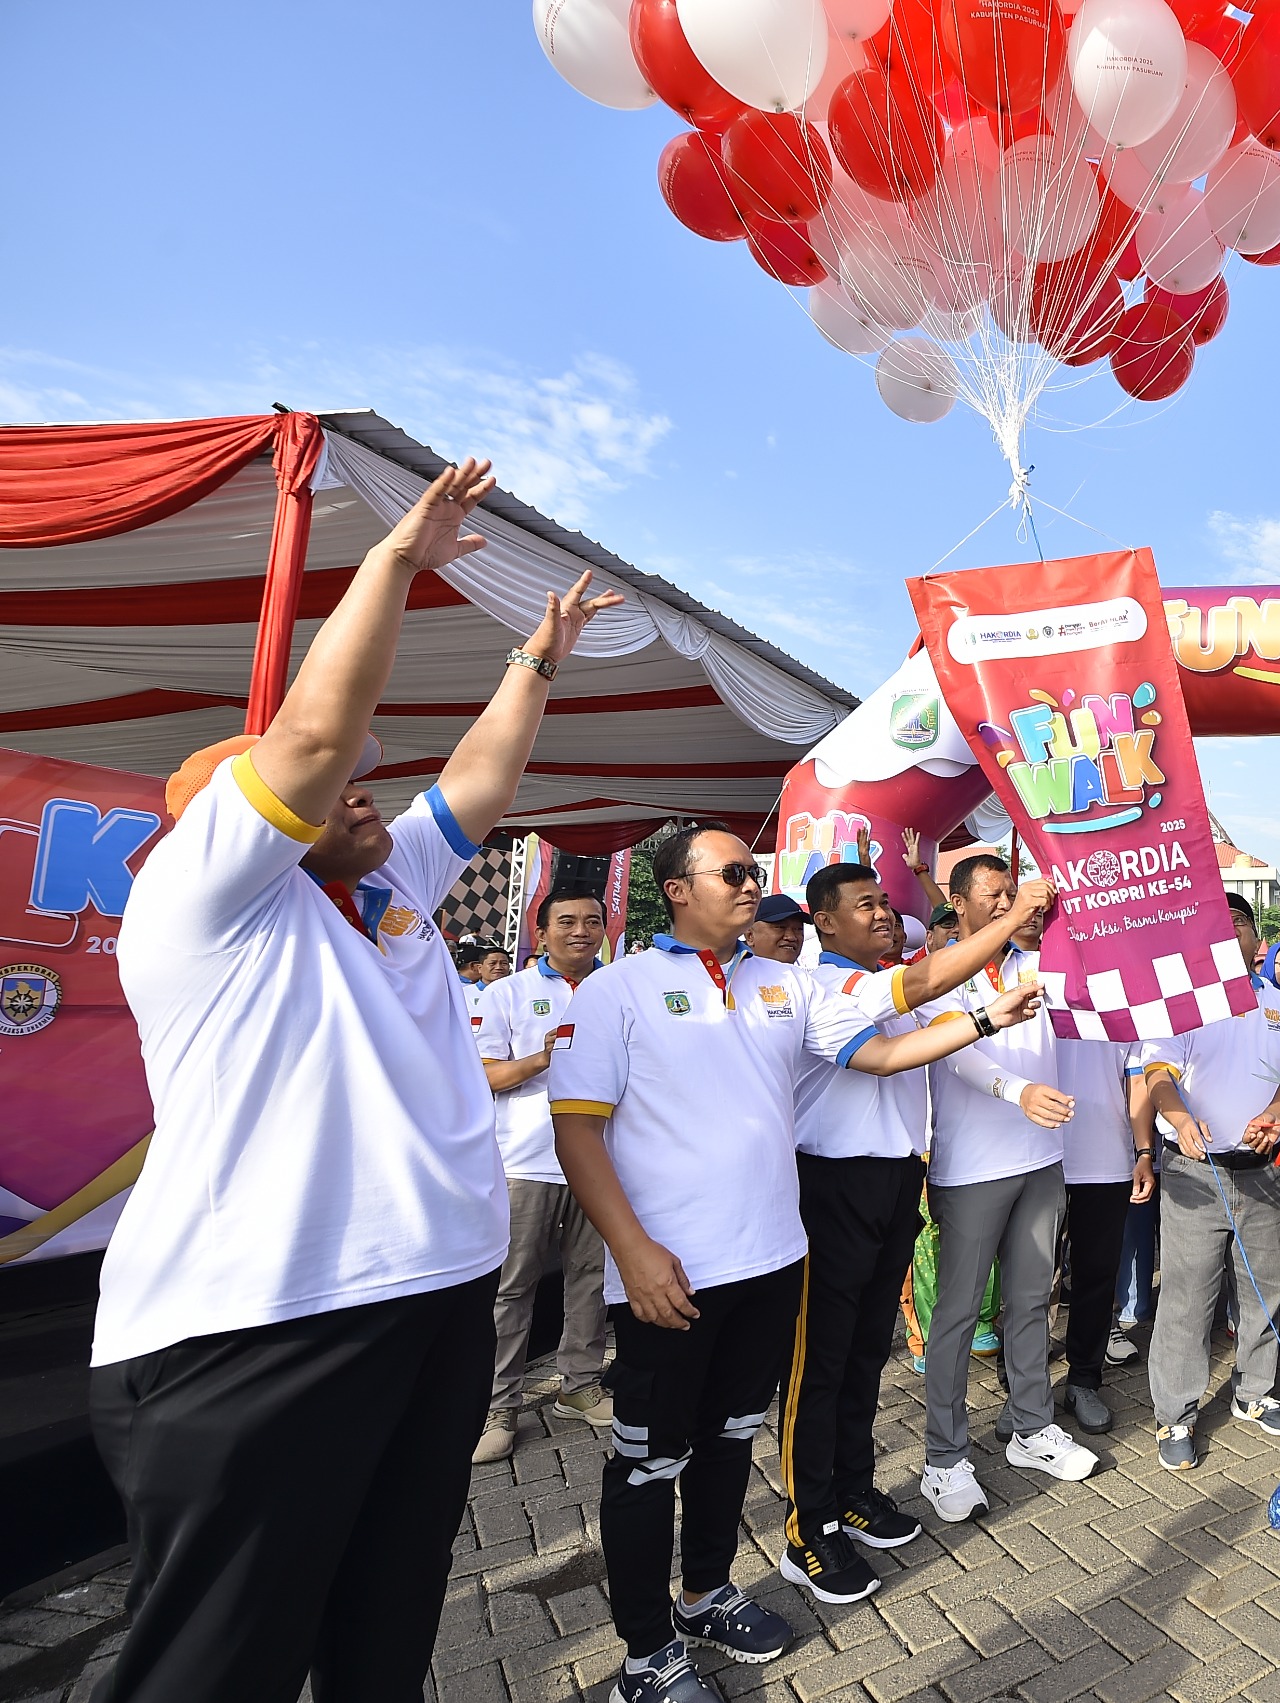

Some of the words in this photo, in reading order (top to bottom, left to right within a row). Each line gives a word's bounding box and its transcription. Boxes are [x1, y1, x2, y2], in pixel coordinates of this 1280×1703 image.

[1022, 5, 1040, 16] 2025
[1008, 690, 1136, 765] FUN
[1007, 728, 1167, 818] WALK
[788, 815, 865, 854] FUN
[1160, 818, 1187, 834] 2025
[1051, 840, 1192, 894] AKORDIA
[1061, 896, 1082, 915] UT
[1084, 884, 1146, 910] KORPRI
[1147, 875, 1193, 897] KE-54
[1089, 919, 1123, 941] Aksi,
[1123, 914, 1158, 932] Basmi
